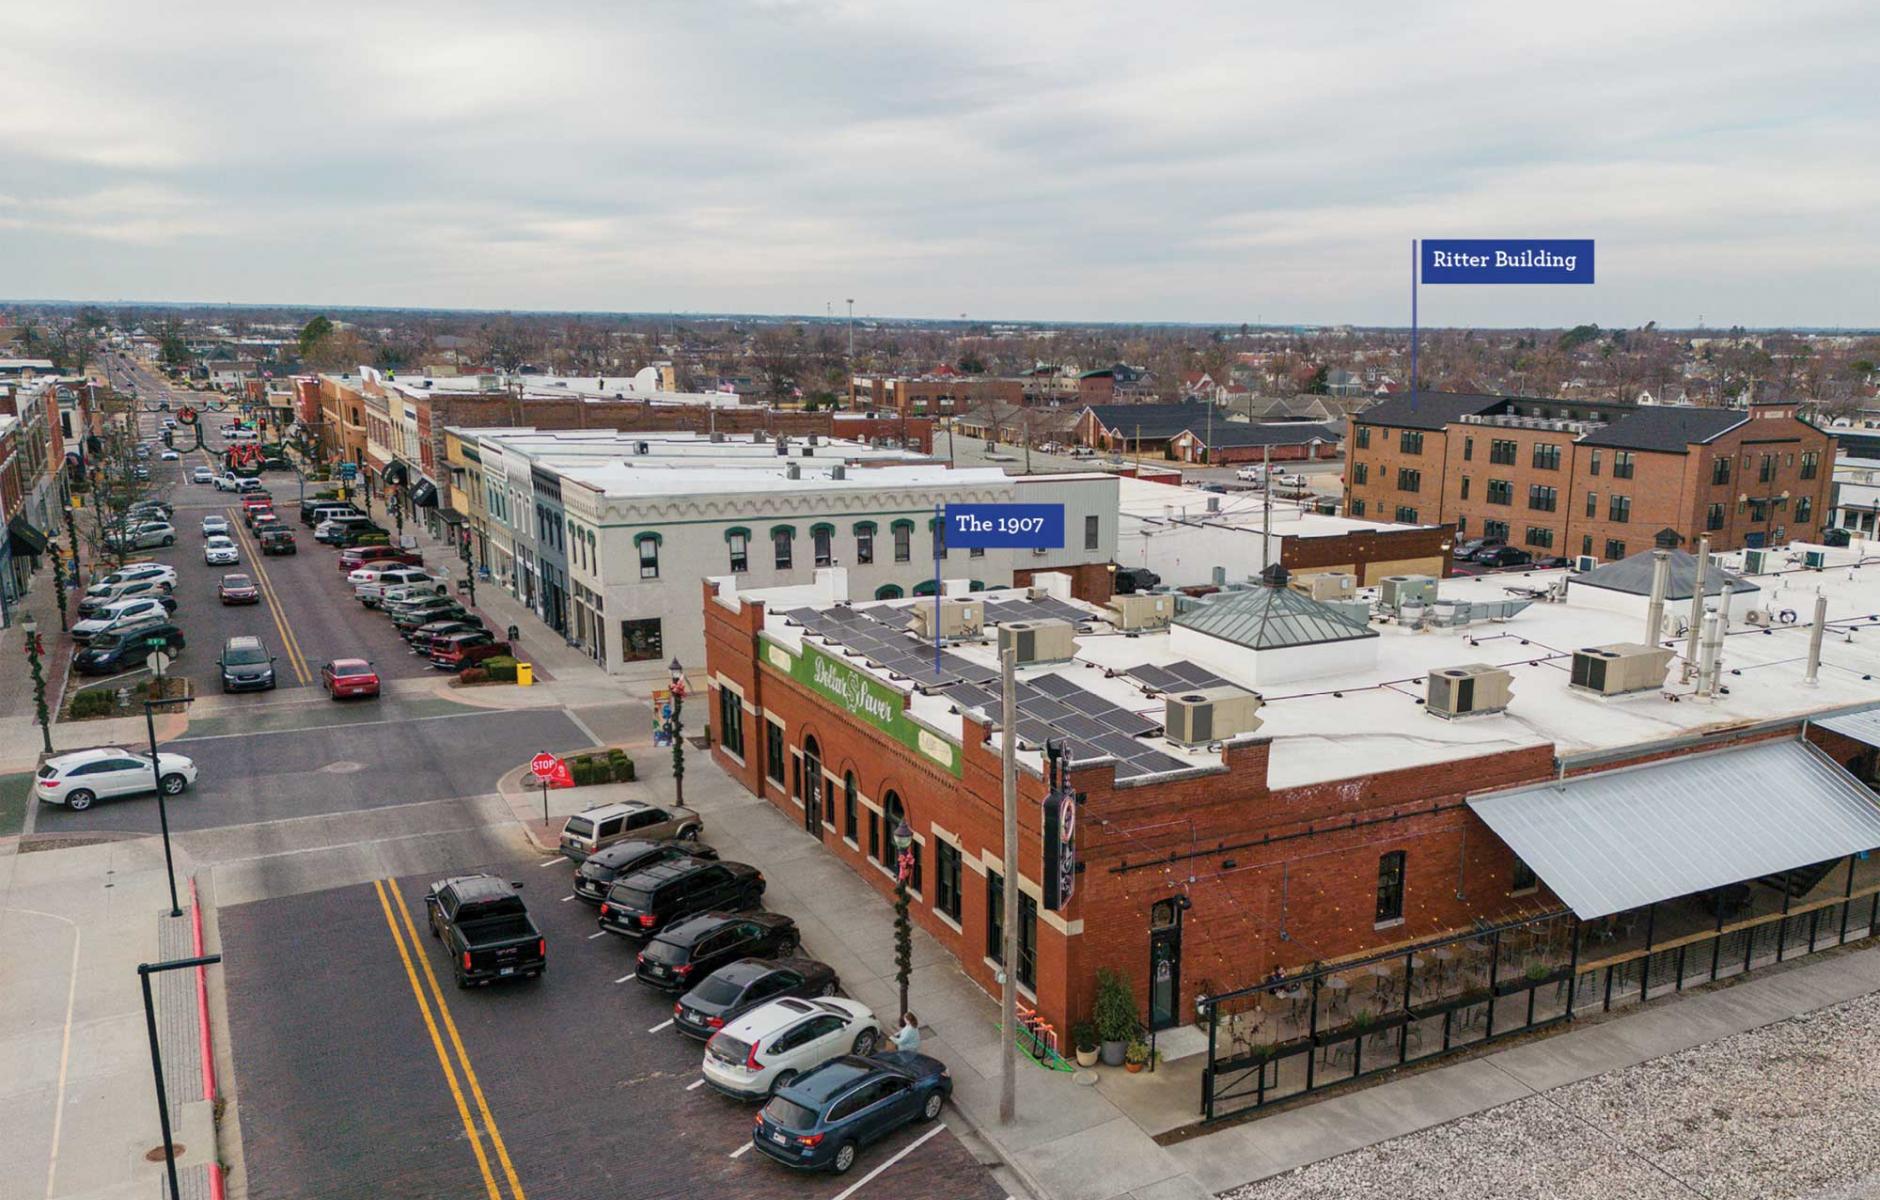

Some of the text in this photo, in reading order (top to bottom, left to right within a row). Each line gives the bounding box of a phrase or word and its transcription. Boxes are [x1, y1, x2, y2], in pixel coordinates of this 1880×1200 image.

[814, 656, 848, 698] Dollar
[856, 680, 893, 722] Saver
[533, 760, 555, 771] STOP
